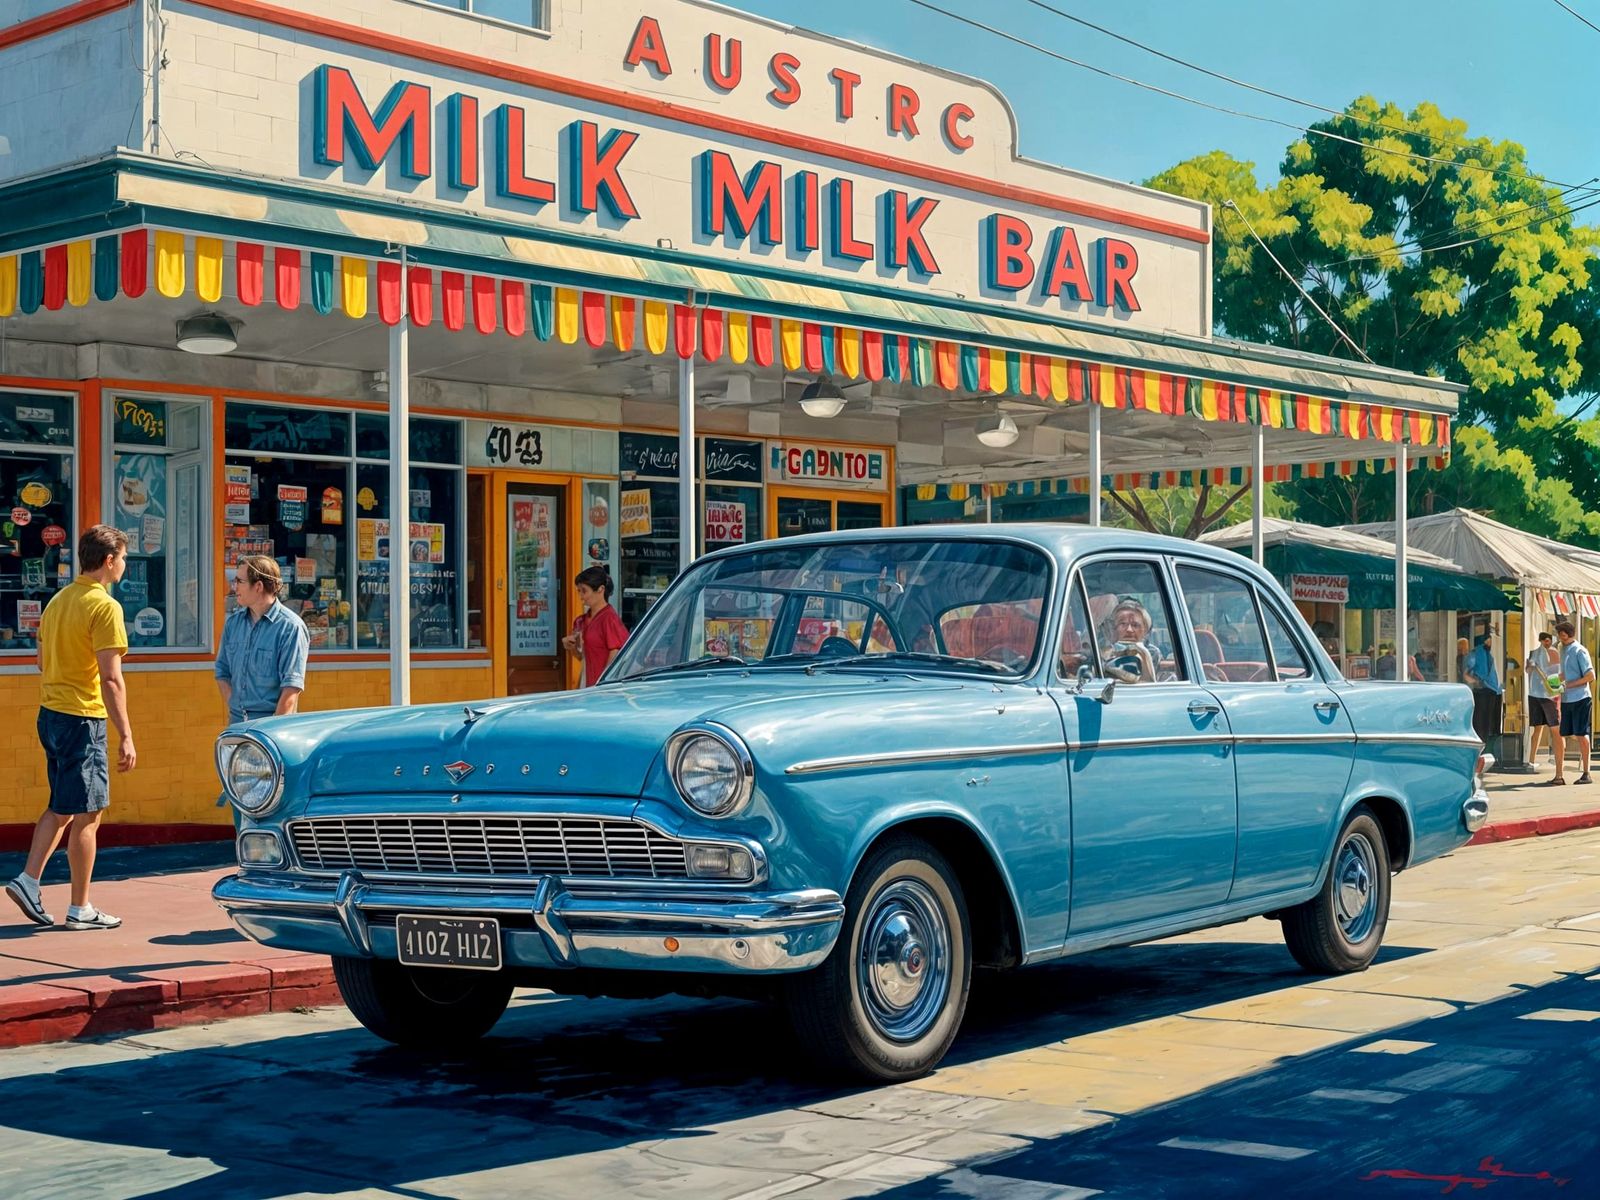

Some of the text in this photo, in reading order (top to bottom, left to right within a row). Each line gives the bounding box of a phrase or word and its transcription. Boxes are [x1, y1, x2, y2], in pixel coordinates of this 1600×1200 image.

[625, 15, 975, 150] AUSTRC
[313, 63, 1141, 312] MILK MILK BAR
